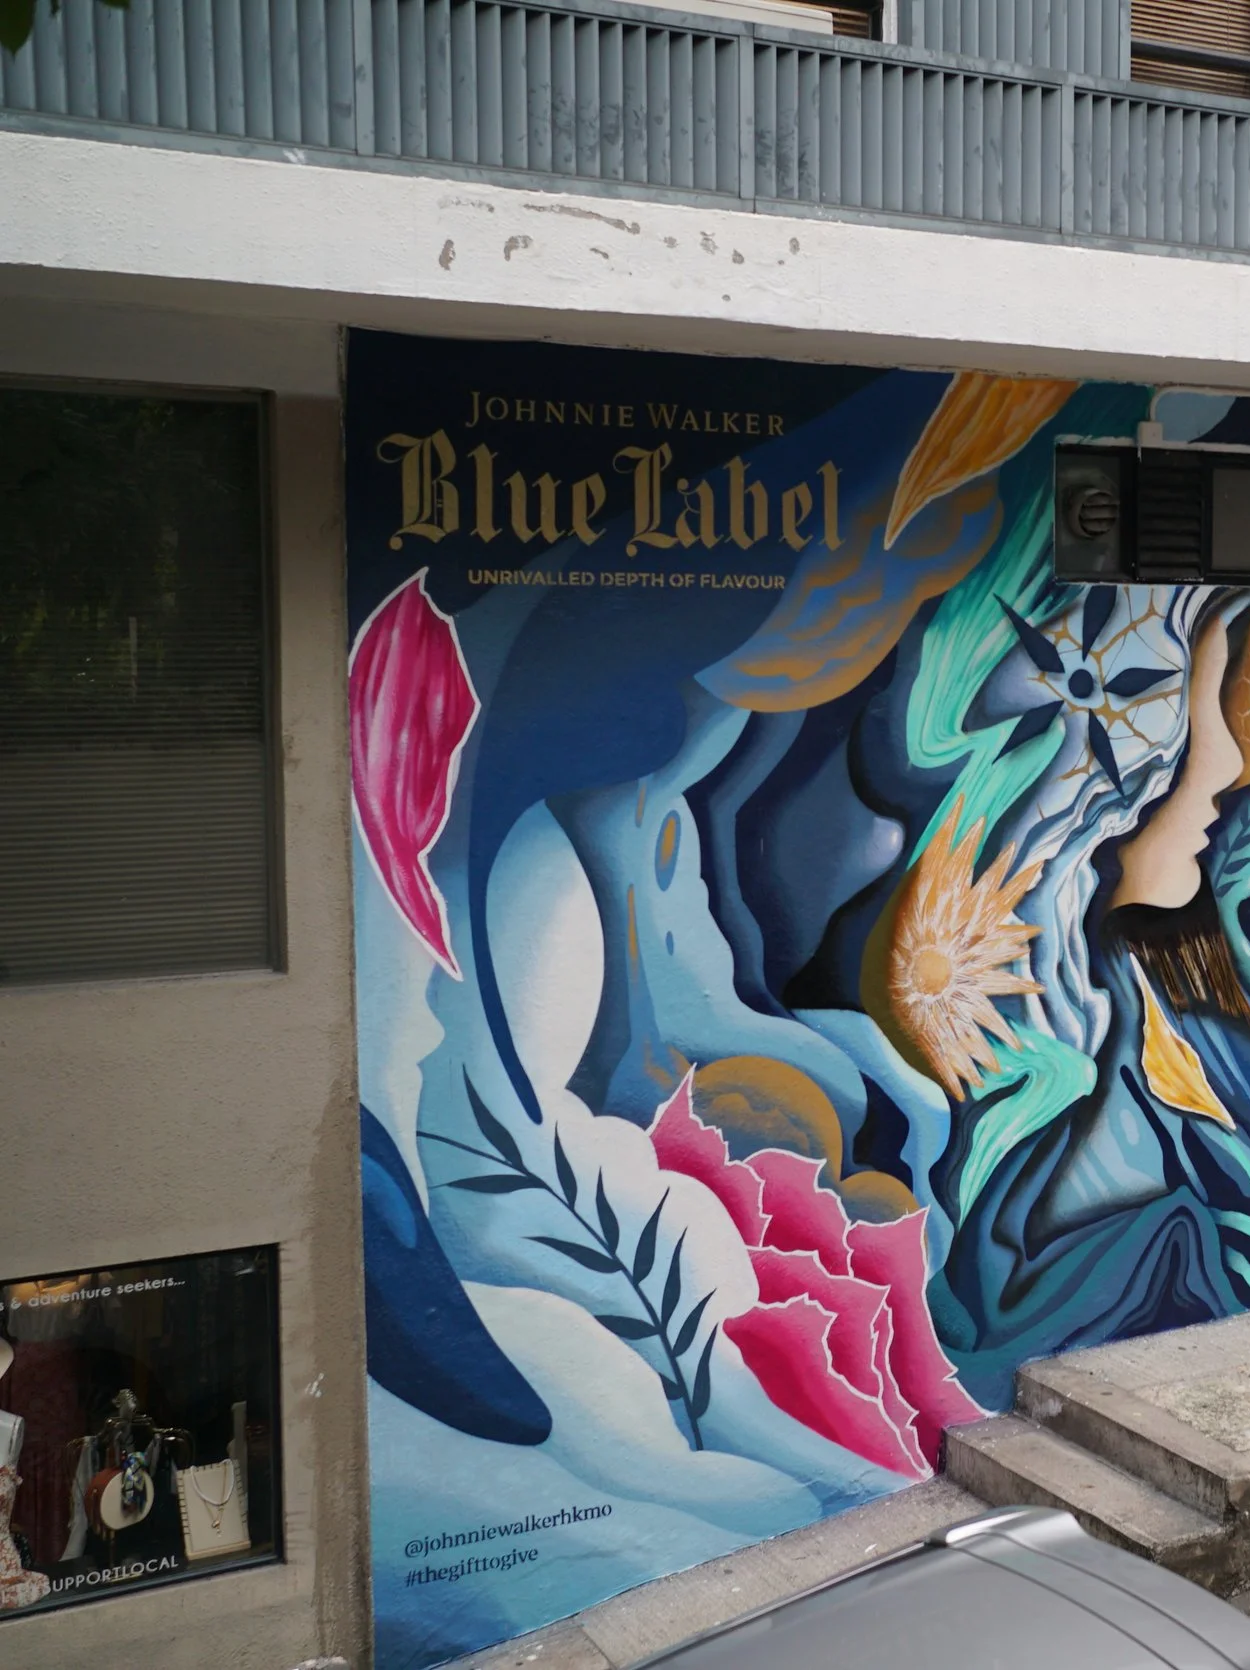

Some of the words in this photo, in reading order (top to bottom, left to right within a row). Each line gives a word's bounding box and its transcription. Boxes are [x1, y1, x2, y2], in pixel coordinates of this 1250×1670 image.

[466, 391, 635, 428] JOHNNIE
[647, 402, 785, 436] WALKER
[376, 428, 607, 551] Blue
[612, 442, 846, 558] Label
[467, 569, 596, 586] UNRIVALLED
[600, 571, 664, 588] DEPTH
[668, 573, 696, 588] OF
[700, 573, 785, 590] FLAVOUR
[28, 1287, 112, 1308] adventure
[404, 1503, 613, 1559] @johnniewalkerhkmo
[405, 1547, 539, 1588] #thegifttogive
